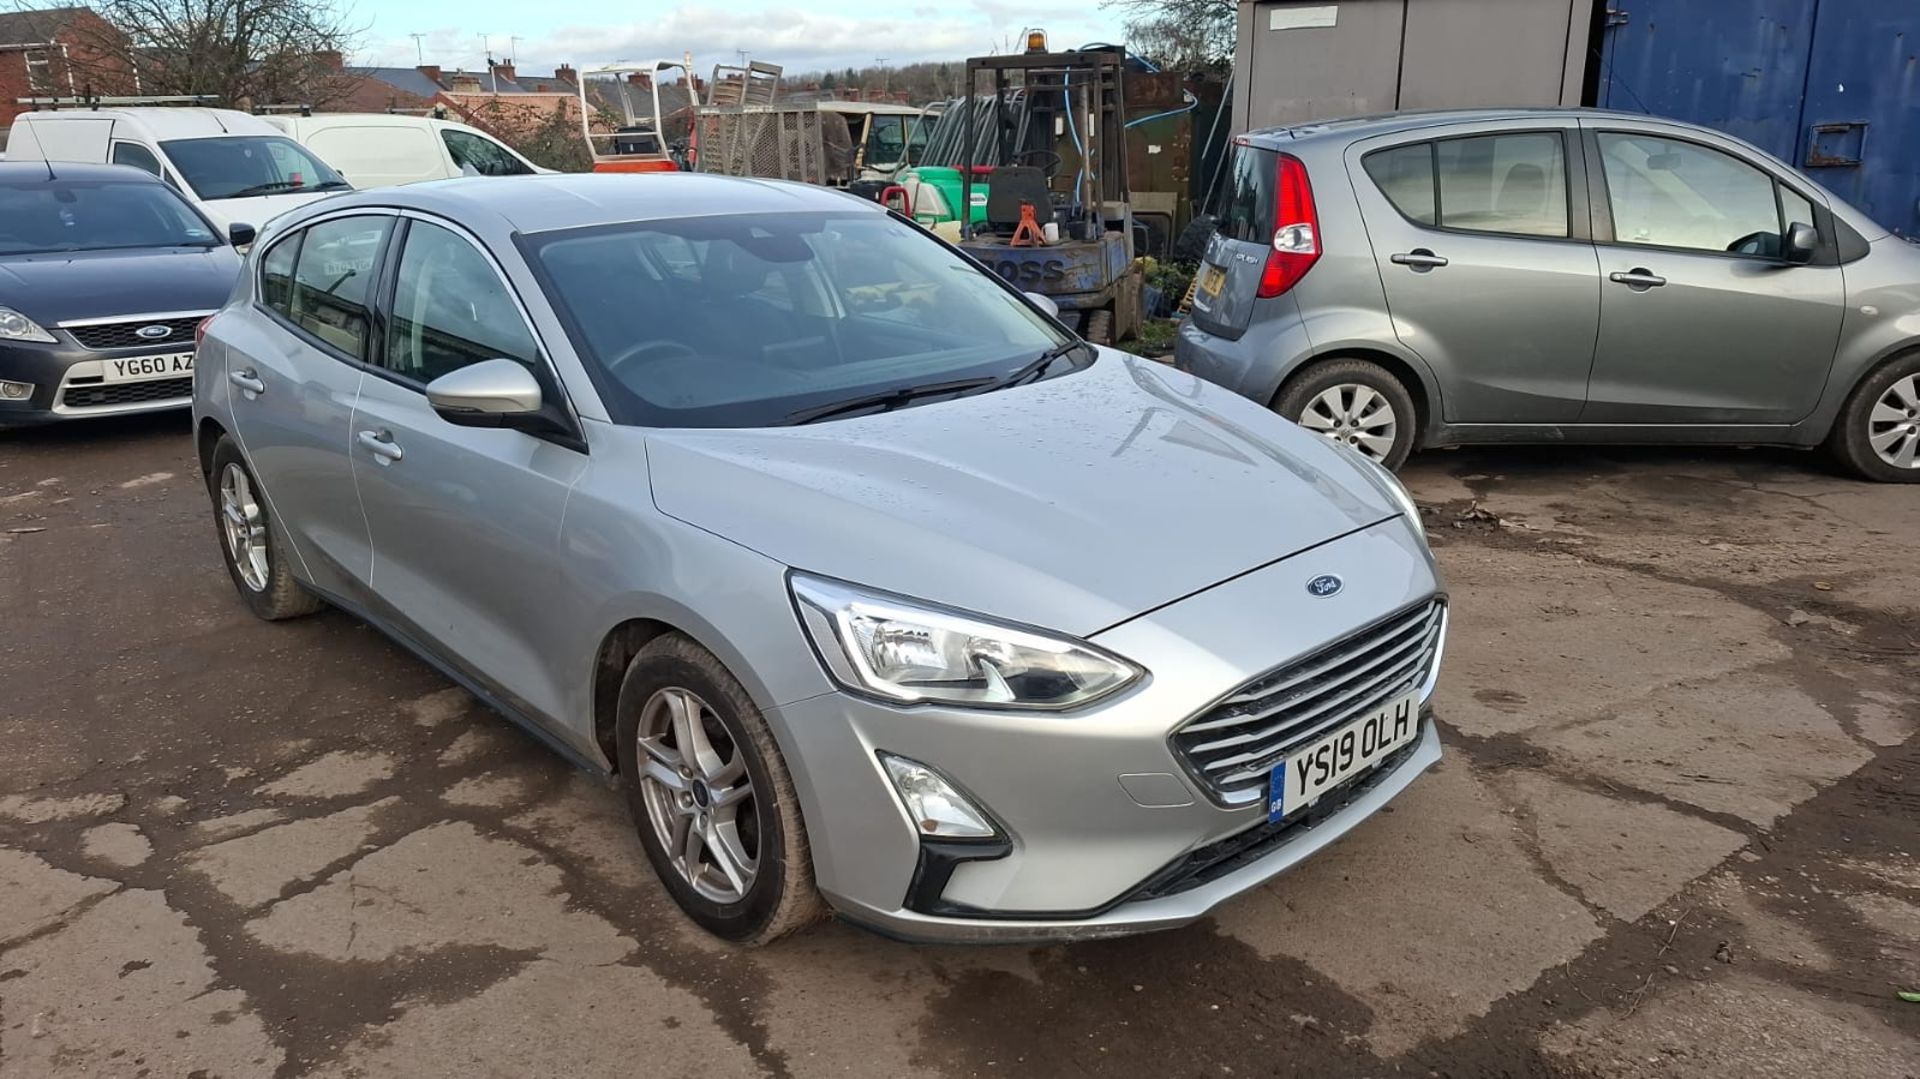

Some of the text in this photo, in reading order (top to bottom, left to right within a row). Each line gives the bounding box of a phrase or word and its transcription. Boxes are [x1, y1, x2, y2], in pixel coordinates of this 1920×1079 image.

[114, 357, 166, 376] YG60
[1313, 576, 1339, 595] Ford
[1297, 699, 1410, 795] YS19 OLH
[1270, 798, 1282, 813] GB
